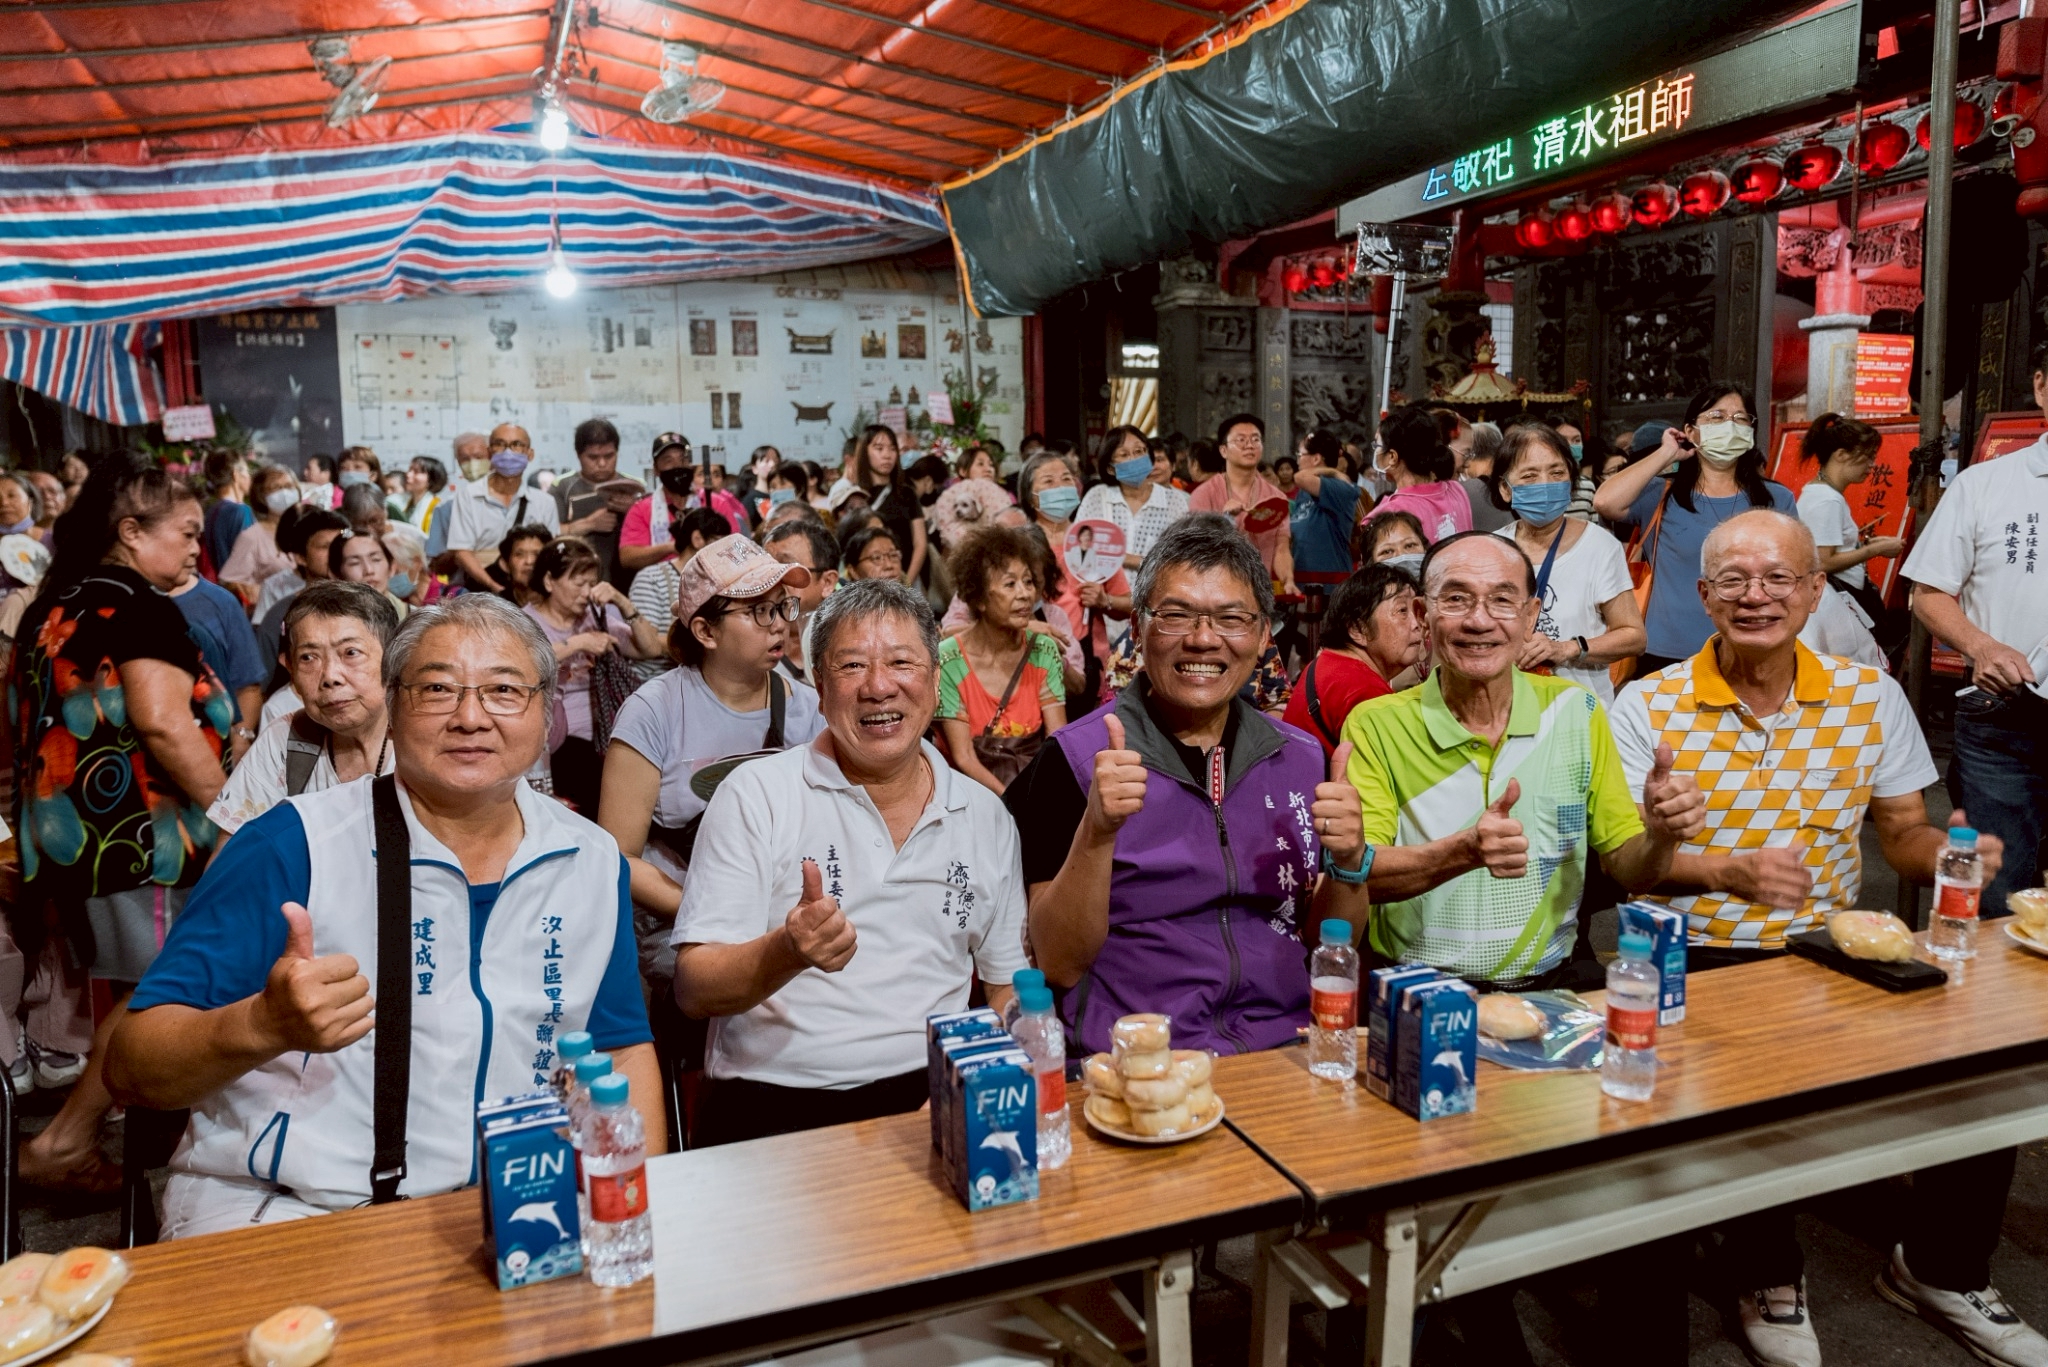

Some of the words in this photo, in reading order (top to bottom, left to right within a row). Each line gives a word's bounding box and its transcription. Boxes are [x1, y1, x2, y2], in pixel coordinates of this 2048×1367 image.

[1533, 73, 1695, 170] 清水祖師
[2004, 521, 2021, 564] 陳安男
[2025, 512, 2039, 574] 副主任委員
[946, 861, 976, 930] 濟德宮
[412, 917, 436, 996] 建成里
[1430, 1008, 1472, 1035] FIN
[977, 1083, 1028, 1115] FIN
[501, 1149, 565, 1187] FIN
